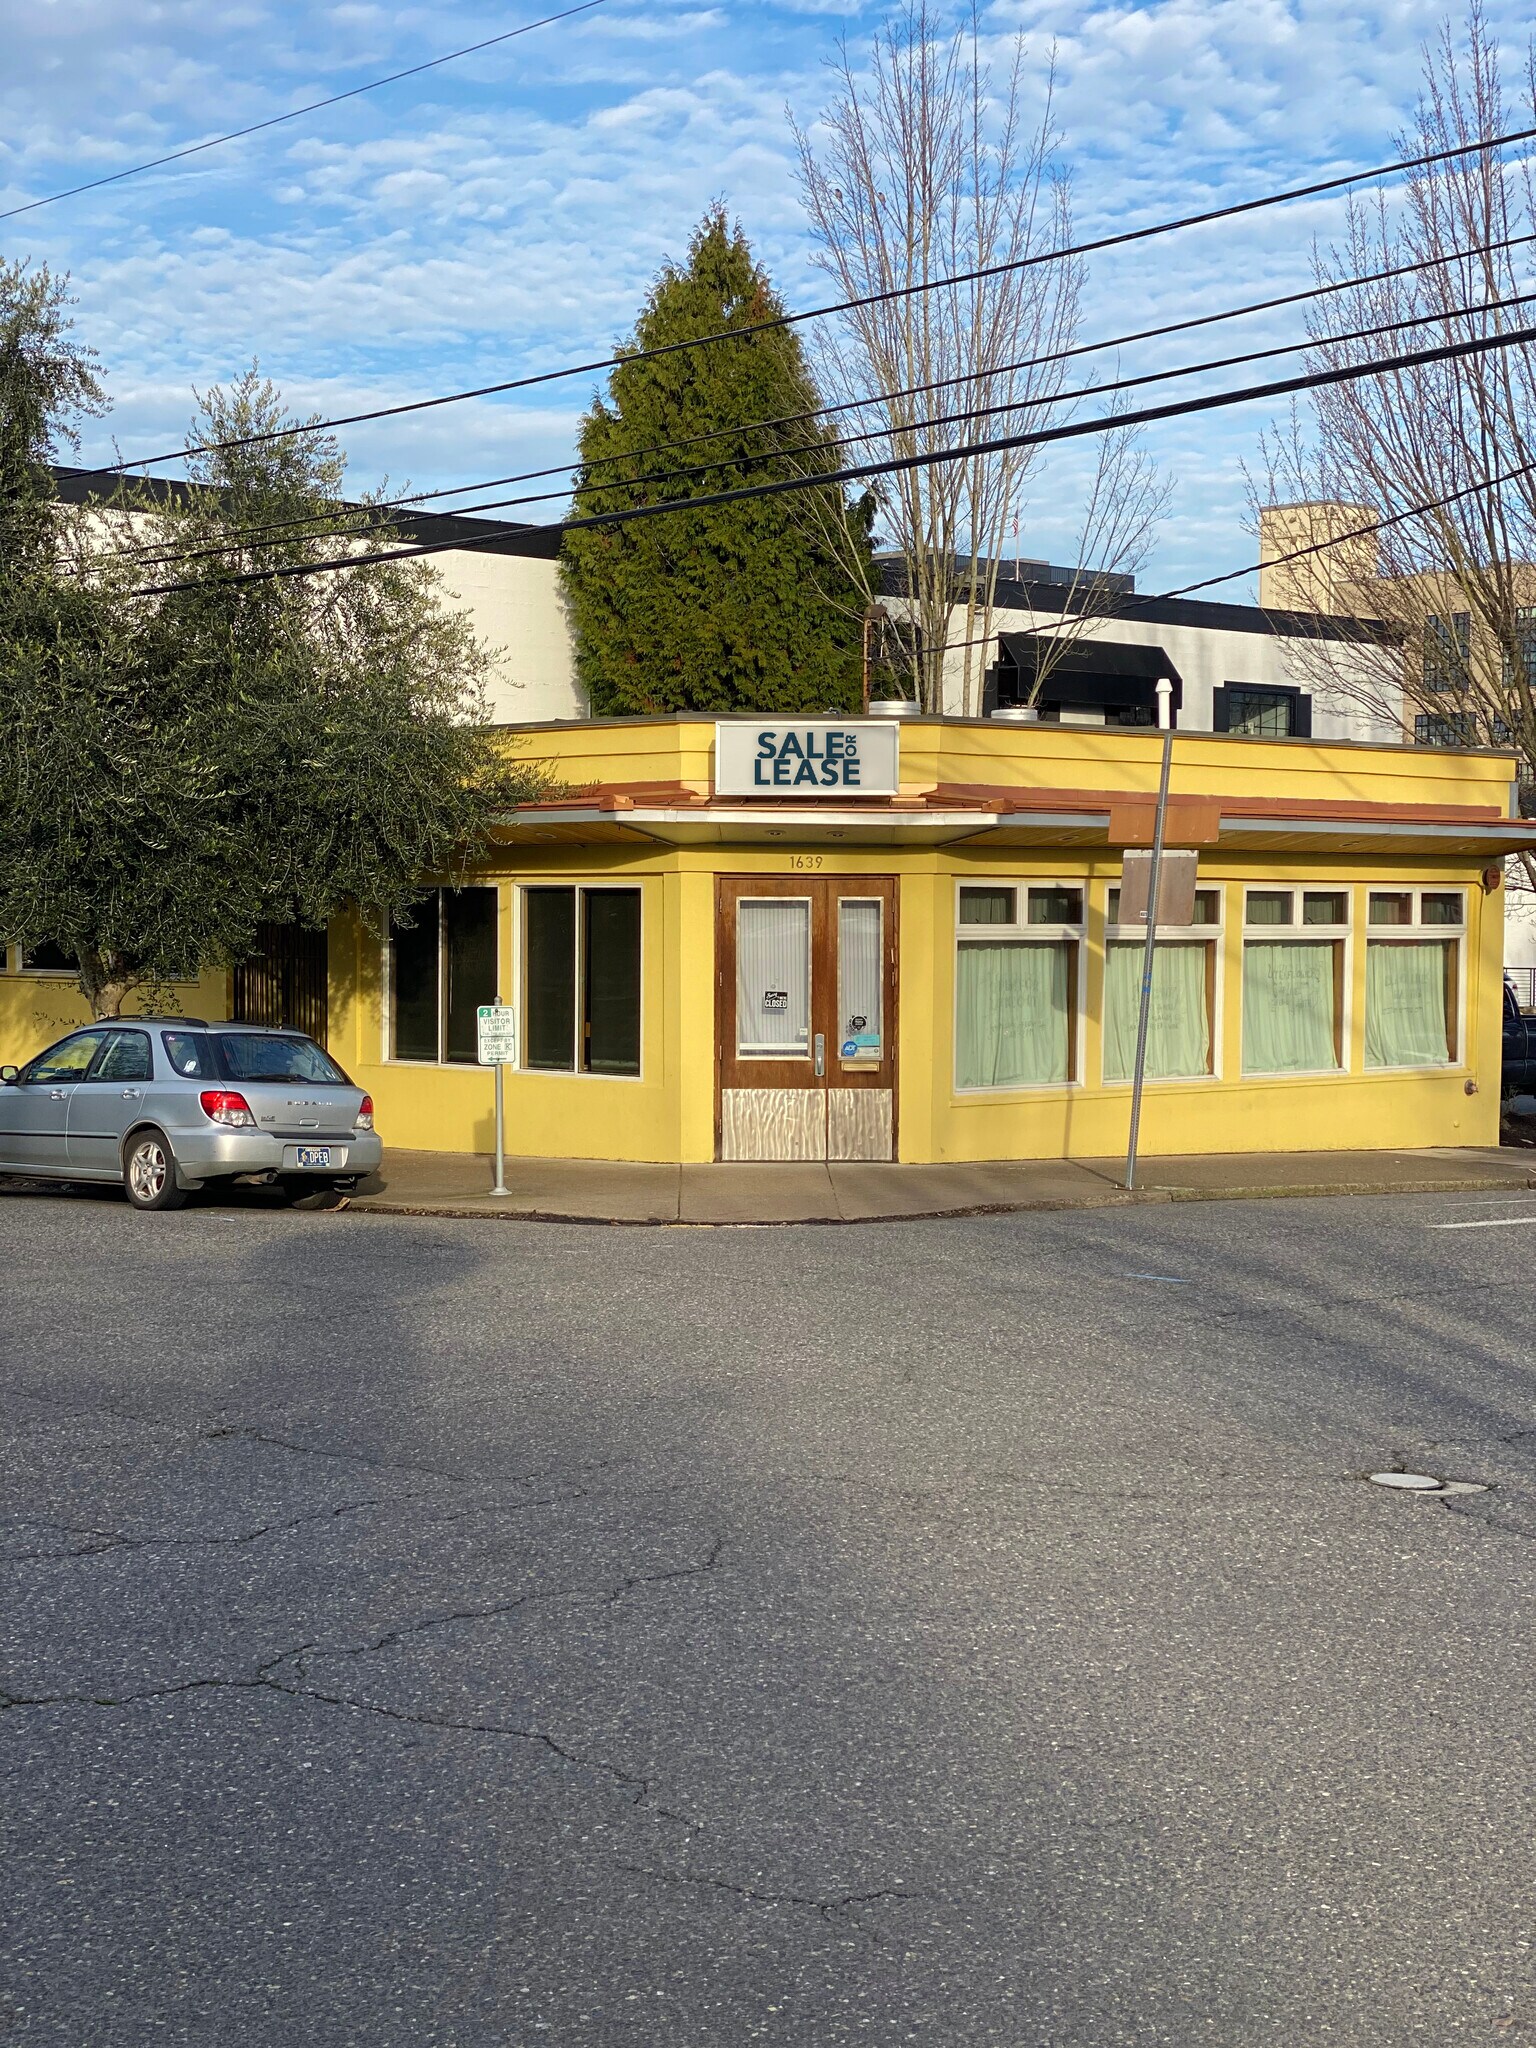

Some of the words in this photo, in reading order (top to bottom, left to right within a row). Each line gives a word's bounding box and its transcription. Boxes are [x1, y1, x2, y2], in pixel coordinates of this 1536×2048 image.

[757, 732, 844, 759] SALE
[845, 735, 857, 757] OR
[754, 759, 861, 786] LEASE
[789, 856, 823, 869] 1639
[764, 999, 787, 1008] CLOSED
